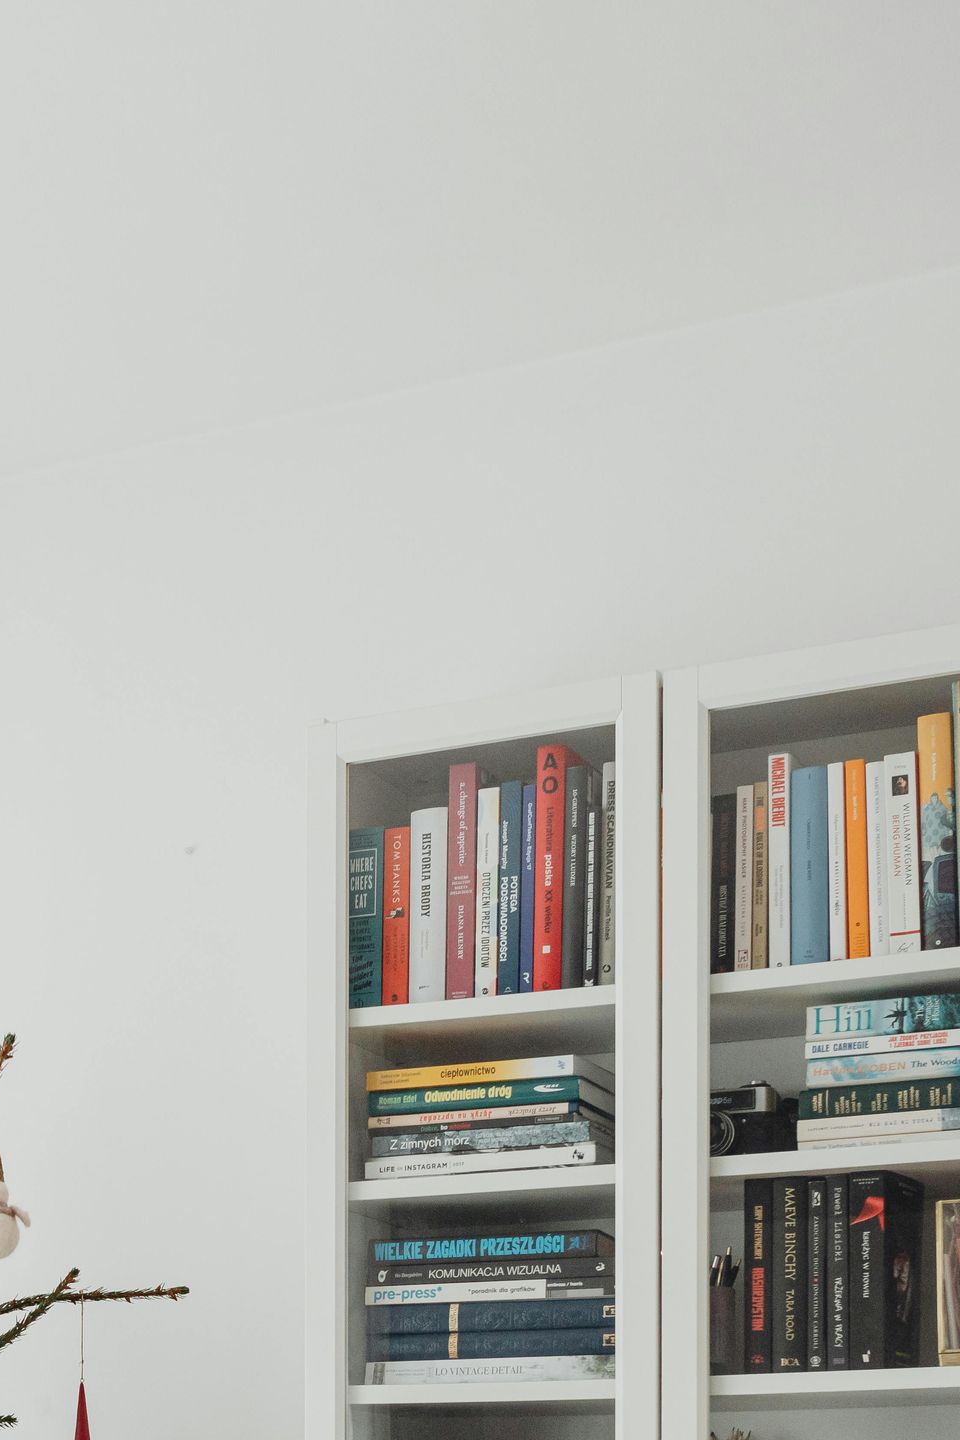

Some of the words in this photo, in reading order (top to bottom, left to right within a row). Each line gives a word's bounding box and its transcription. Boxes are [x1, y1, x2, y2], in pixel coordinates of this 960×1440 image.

[544, 753, 558, 771] A
[543, 776, 558, 794] O
[771, 757, 785, 795] MICHAEL
[457, 791, 467, 820] change
[607, 781, 615, 812] DRESS
[756, 796, 764, 807] THE
[459, 821, 467, 830] of
[771, 798, 786, 827] BIERUT
[902, 803, 911, 842] WILLIAM
[544, 807, 554, 851] Literatura
[892, 814, 900, 840] BEING
[393, 835, 401, 860] TOM
[421, 833, 431, 881] HISTORIA
[456, 831, 467, 865] appetite
[606, 815, 615, 888] SCANDINAVIAN
[893, 842, 901, 877] HUMAN
[350, 856, 373, 871] WHERE
[543, 854, 553, 886] polska
[904, 844, 912, 886] WEGMAN
[350, 874, 373, 890] CHEFS
[392, 864, 400, 903] HANKS
[482, 872, 490, 909] OTOCZENI
[509, 876, 518, 913] POTĘGA
[355, 893, 367, 909] EAT
[421, 885, 430, 917] BRODY
[544, 890, 553, 902] XX
[481, 911, 490, 934] PRZEZ
[500, 877, 510, 961] PODŚWIADOMOŚCI
[544, 906, 553, 933] wieku
[480, 937, 490, 968] IDIOTÓW
[812, 1005, 873, 1035] Hill
[812, 1043, 829, 1053] DALE
[833, 1041, 869, 1051] CARNEGIE
[440, 1065, 496, 1079] ciepłownictwo
[379, 1096, 401, 1105] Roman
[403, 1095, 417, 1104] Edel
[425, 1086, 485, 1103] Odwodnienie
[488, 1084, 512, 1098] dróg
[535, 1106, 557, 1114] Jerzy
[390, 1140, 398, 1150] Z
[400, 1135, 441, 1150] zimnych
[444, 1135, 470, 1146] mórz
[405, 1162, 448, 1171] INSTAGRAM
[784, 1188, 795, 1227] MAEVE
[834, 1187, 842, 1215] Paweł
[375, 1242, 422, 1261] WIELKIE
[427, 1238, 477, 1259] ZAGADKI
[480, 1234, 565, 1257] PRZESZŁOŚCI
[834, 1222, 842, 1262] Lisicki
[862, 1231, 871, 1260] księżyc
[784, 1233, 796, 1280] BINCHY
[863, 1262, 870, 1270] w
[428, 1266, 504, 1279] KOMUNIKACJA
[507, 1264, 562, 1276] WIZUALNA
[510, 1286, 536, 1294] grafików
[751, 1267, 764, 1331] ABSURDYSTAN
[786, 1290, 794, 1312] TARA
[785, 1315, 794, 1341] ROAD
[834, 1324, 843, 1348] PRACY
[450, 1366, 490, 1376] VINTAGE
[781, 1358, 800, 1367] BCA
